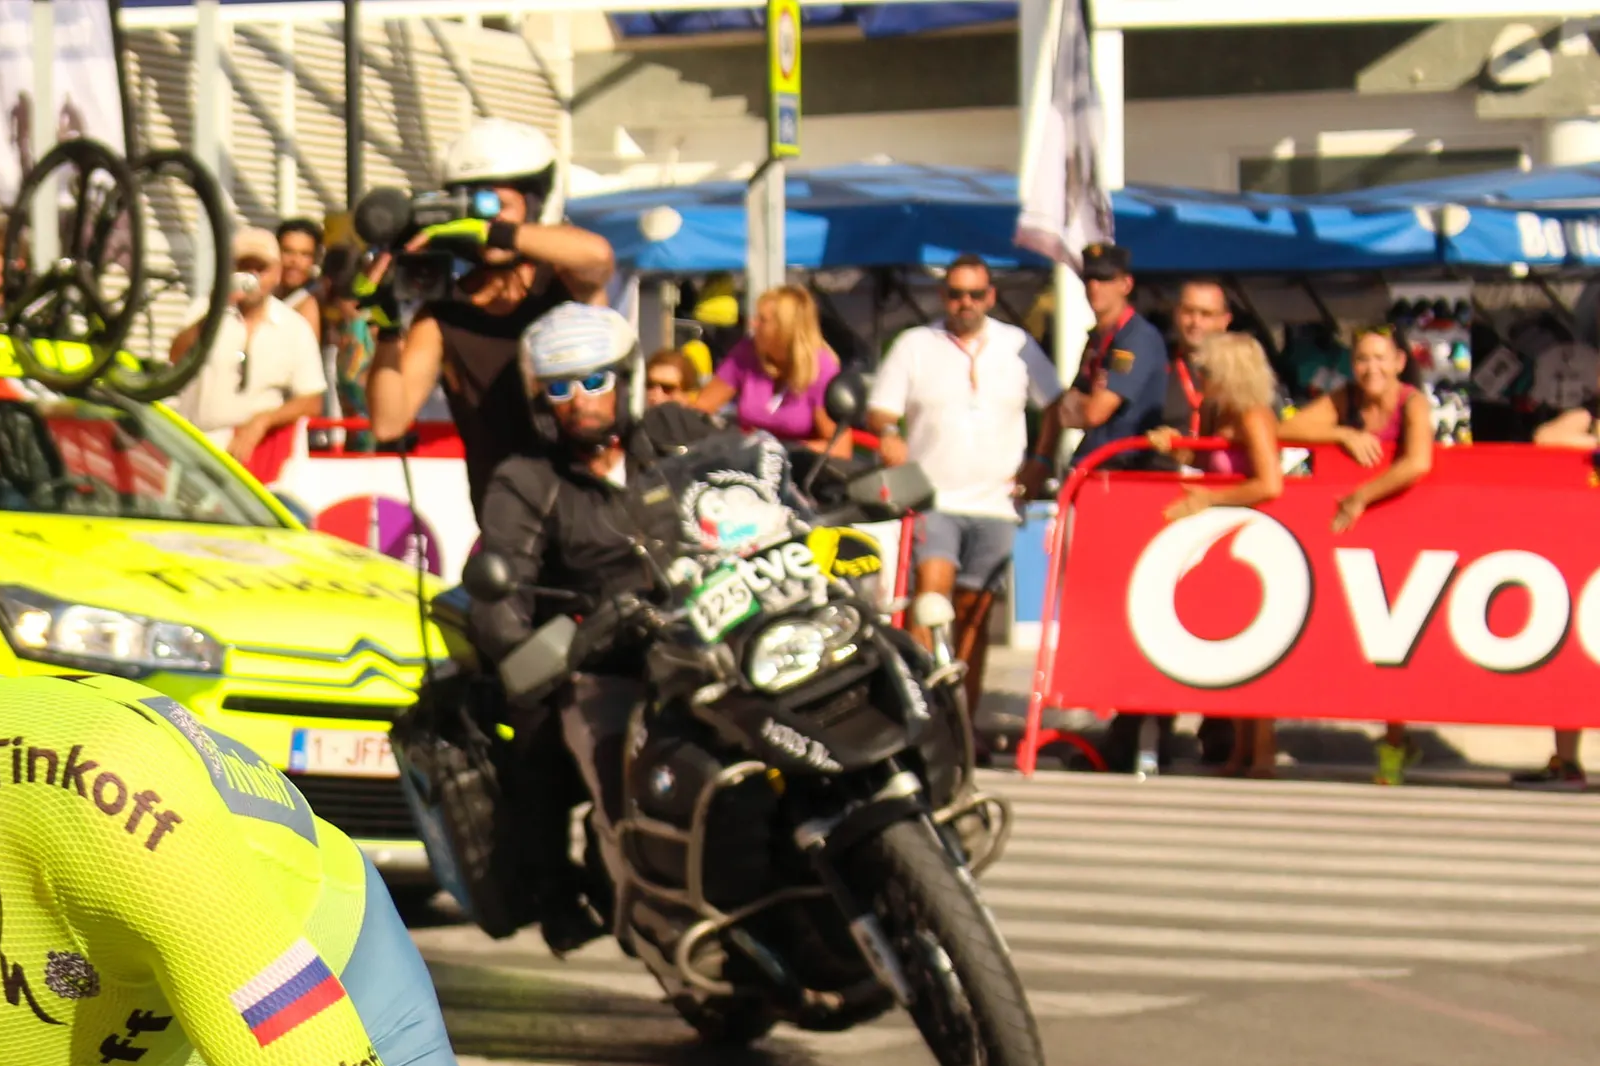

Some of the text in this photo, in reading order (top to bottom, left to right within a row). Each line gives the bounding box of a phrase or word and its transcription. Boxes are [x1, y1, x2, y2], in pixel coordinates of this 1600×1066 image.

[736, 542, 820, 594] tve
[700, 582, 748, 630] 225
[1334, 548, 1600, 674] vo
